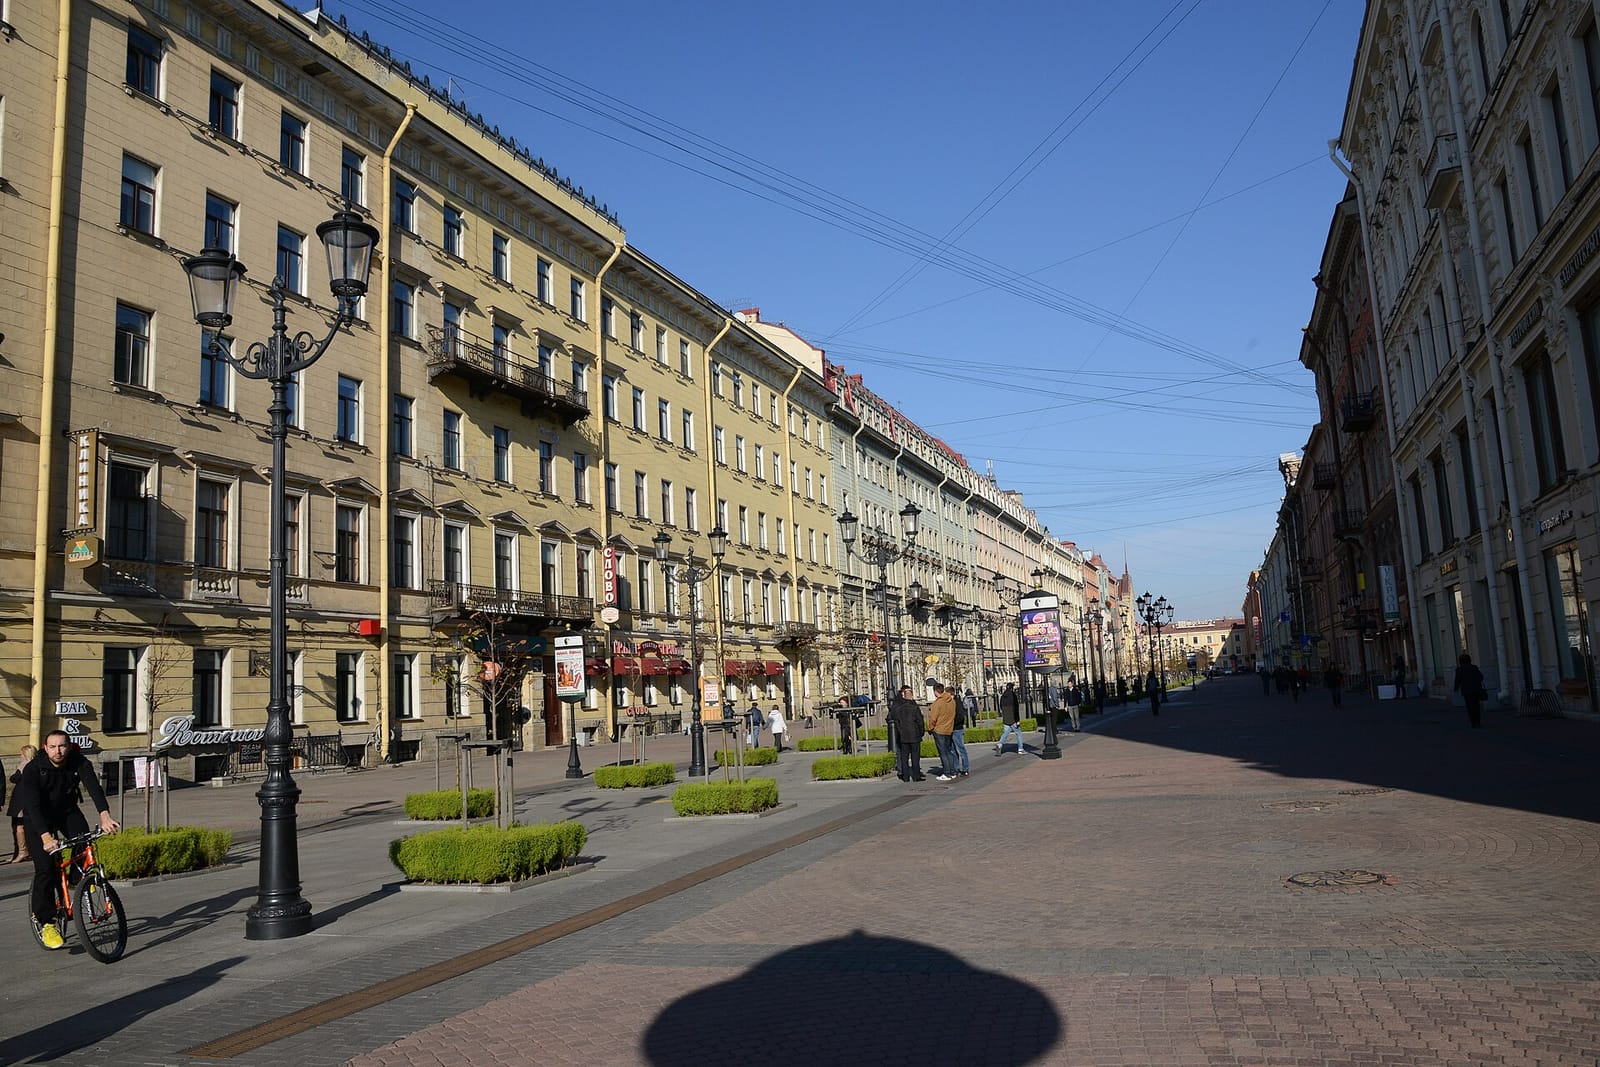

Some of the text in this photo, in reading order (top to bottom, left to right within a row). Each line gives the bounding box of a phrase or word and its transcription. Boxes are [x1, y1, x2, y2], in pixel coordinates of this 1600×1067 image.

[78, 435, 90, 526] КЛИНИКА
[603, 547, 615, 603] СЛОВО
[1384, 567, 1397, 611] УКРОП
[59, 702, 87, 714] BAR
[65, 719, 80, 733] &
[152, 714, 265, 747] Romanov
